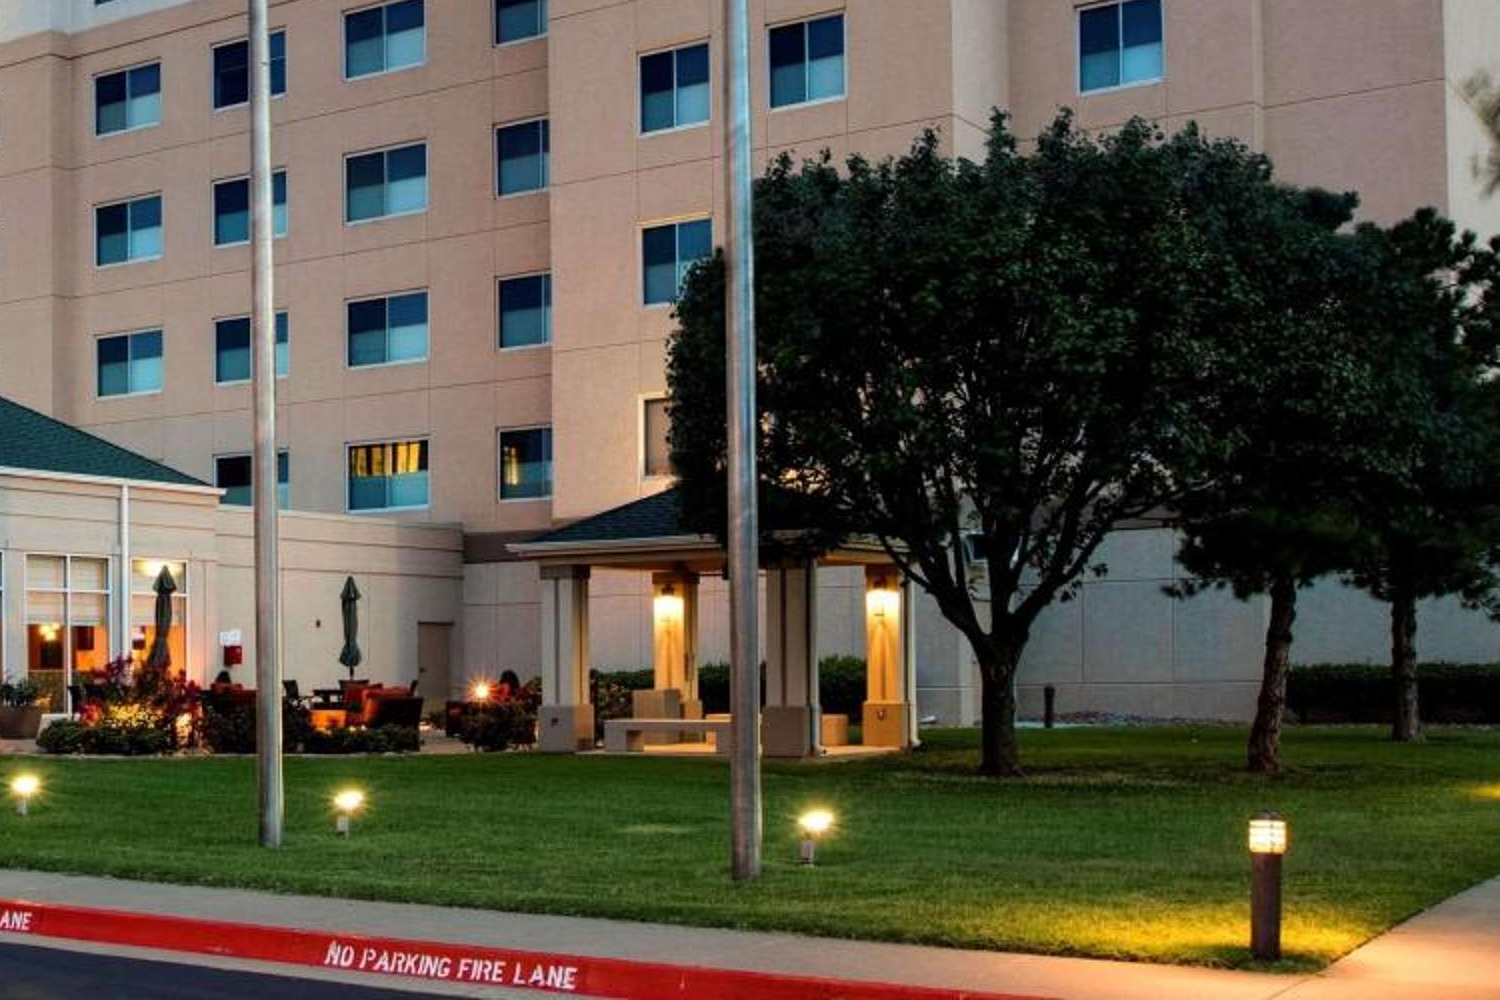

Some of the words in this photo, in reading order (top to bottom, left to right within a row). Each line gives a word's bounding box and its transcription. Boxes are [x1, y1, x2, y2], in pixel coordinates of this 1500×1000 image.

[324, 940, 355, 967] NO
[359, 947, 451, 979] PARKING
[456, 958, 507, 983] FIRE
[512, 962, 579, 990] LANE
